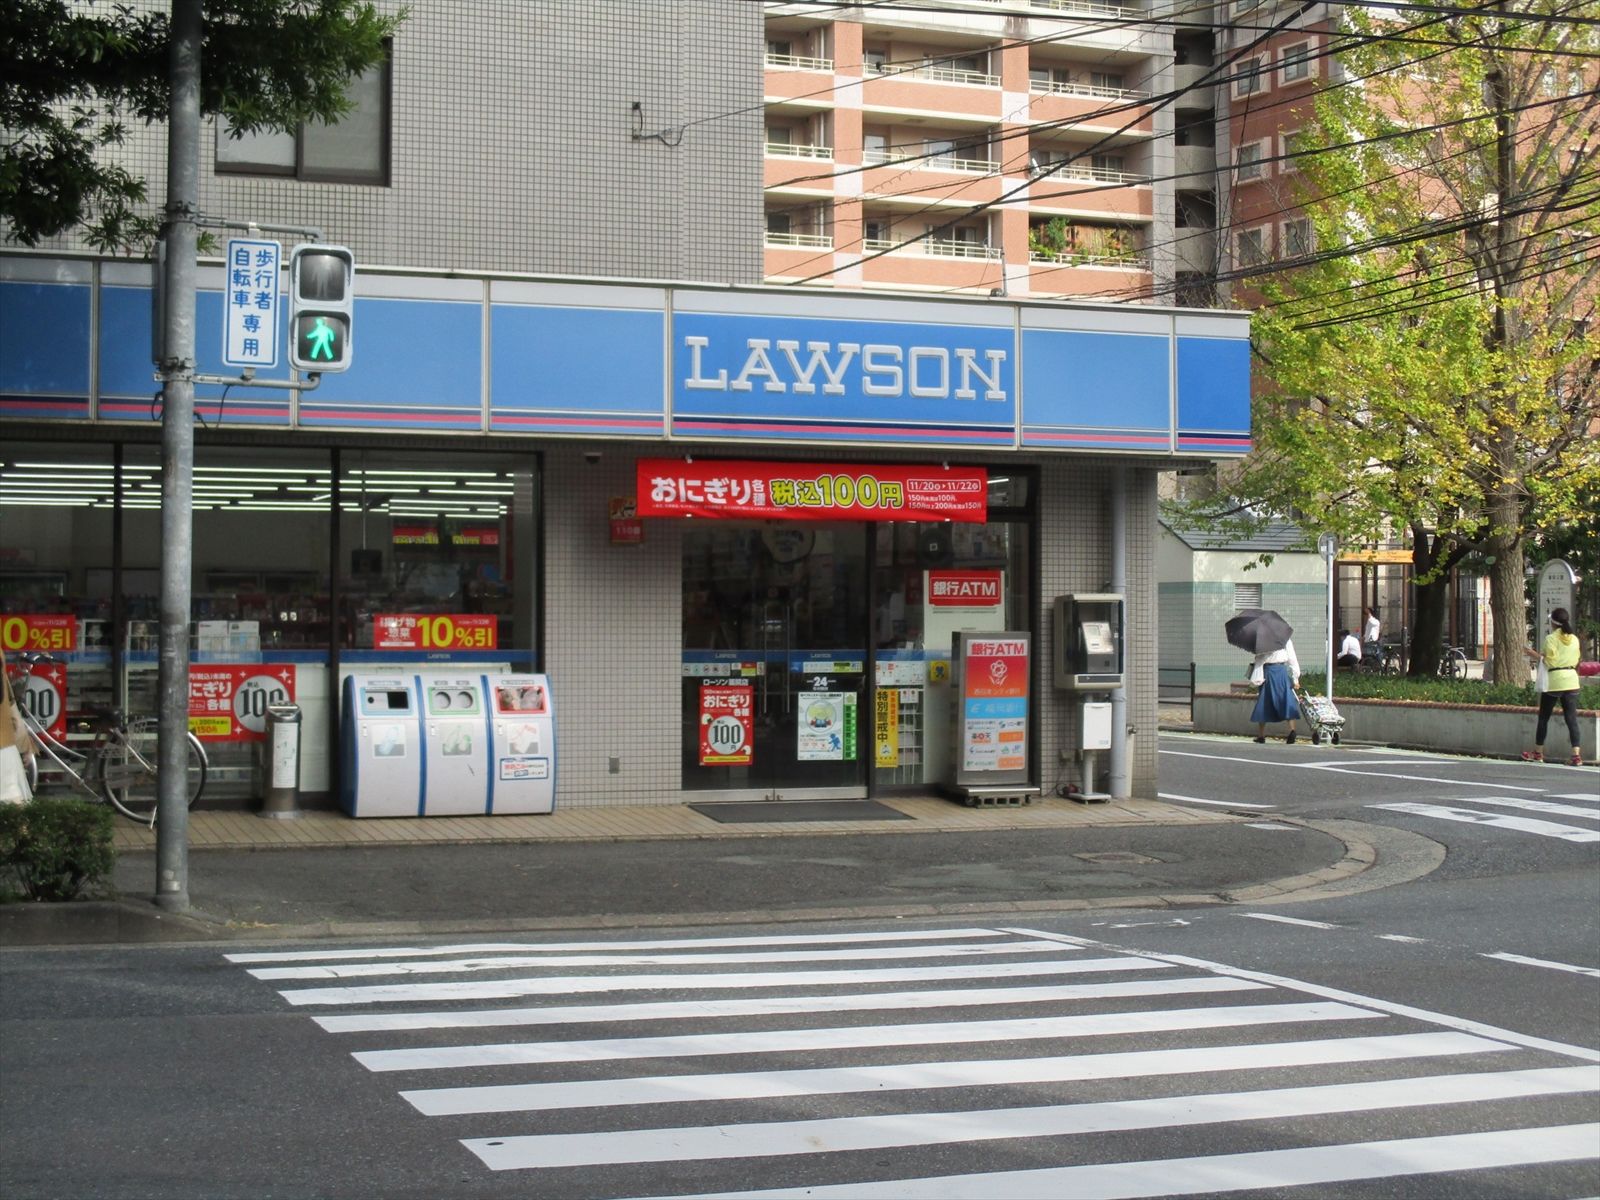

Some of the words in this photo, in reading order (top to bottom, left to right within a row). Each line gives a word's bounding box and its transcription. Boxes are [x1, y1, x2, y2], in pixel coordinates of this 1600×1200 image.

[232, 247, 252, 308] 自転車
[254, 249, 274, 310] 歩行者
[242, 314, 261, 357] 専用
[684, 335, 1008, 402] LAWSON
[651, 476, 751, 505] おにぎり
[769, 474, 904, 508] 税込100円
[933, 581, 997, 596] 銀行ATM
[0, 617, 71, 649] 0%引
[971, 643, 1025, 656] 銀行ATM
[813, 676, 828, 687] 24
[704, 695, 750, 708] おにぎり
[712, 724, 741, 745] 100
